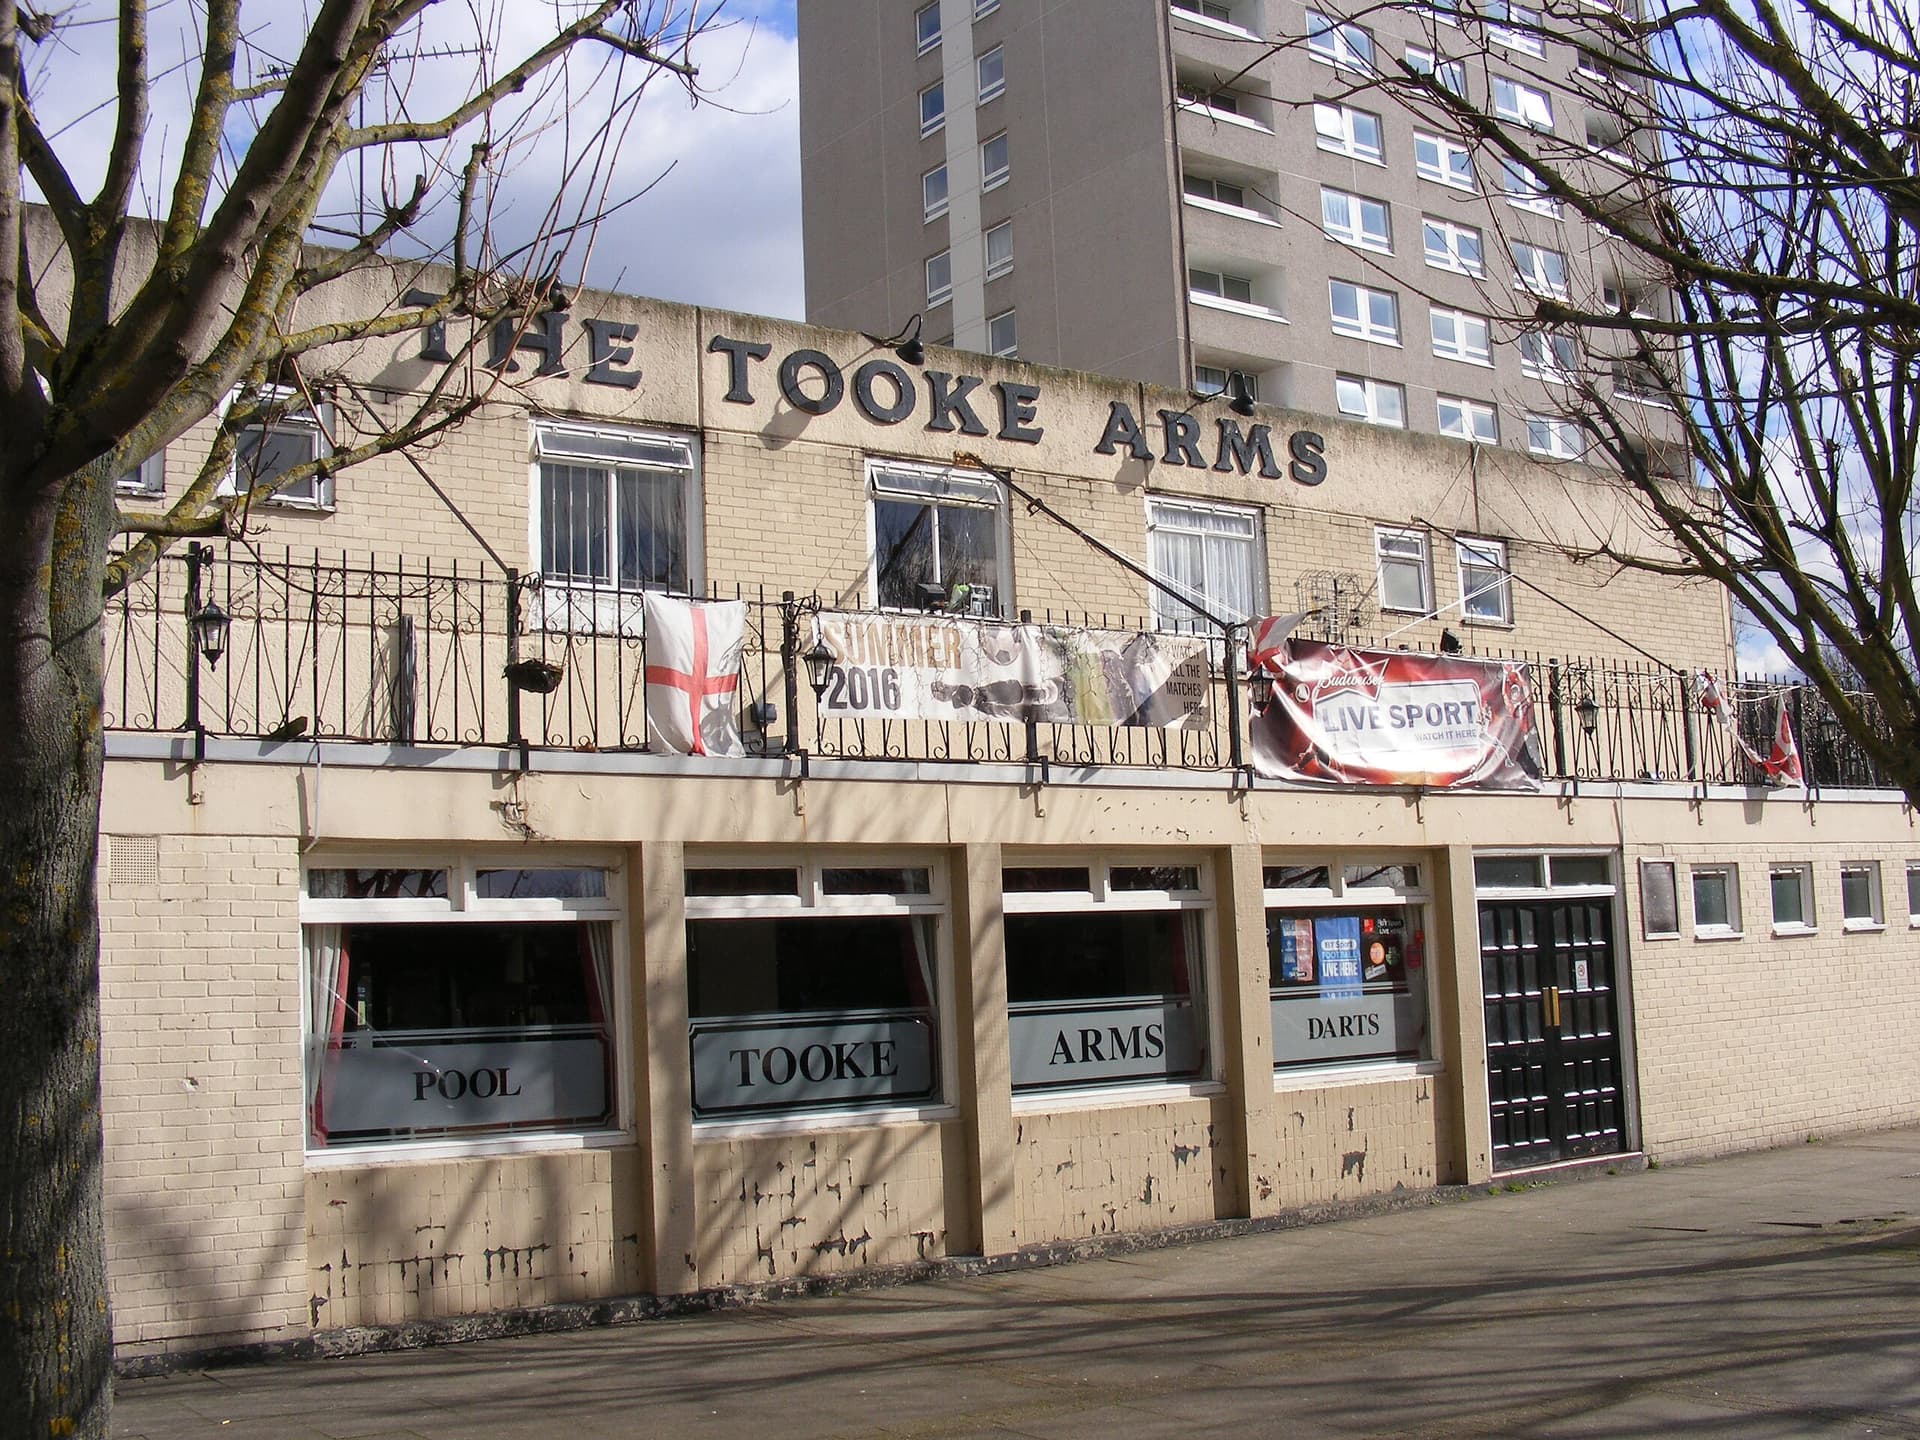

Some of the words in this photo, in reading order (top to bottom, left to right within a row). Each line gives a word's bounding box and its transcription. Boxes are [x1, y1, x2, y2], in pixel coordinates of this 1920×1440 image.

[404, 287, 643, 390] THE
[707, 334, 1045, 445] TOOKE
[1094, 400, 1328, 487] ARMS
[824, 619, 962, 669] SUMMER
[828, 665, 902, 710] 2016
[1186, 664, 1201, 678] THE
[1166, 681, 1202, 697] MATCHES
[1322, 705, 1383, 733] LIVE
[1389, 700, 1477, 729] SPORT
[1455, 729, 1478, 739] HERE
[1322, 961, 1339, 977] LIVE
[1308, 1013, 1380, 1040] DARTS
[1049, 1023, 1166, 1066] ARMS
[729, 1040, 899, 1088] TOOKE
[413, 1067, 521, 1102] POOL
